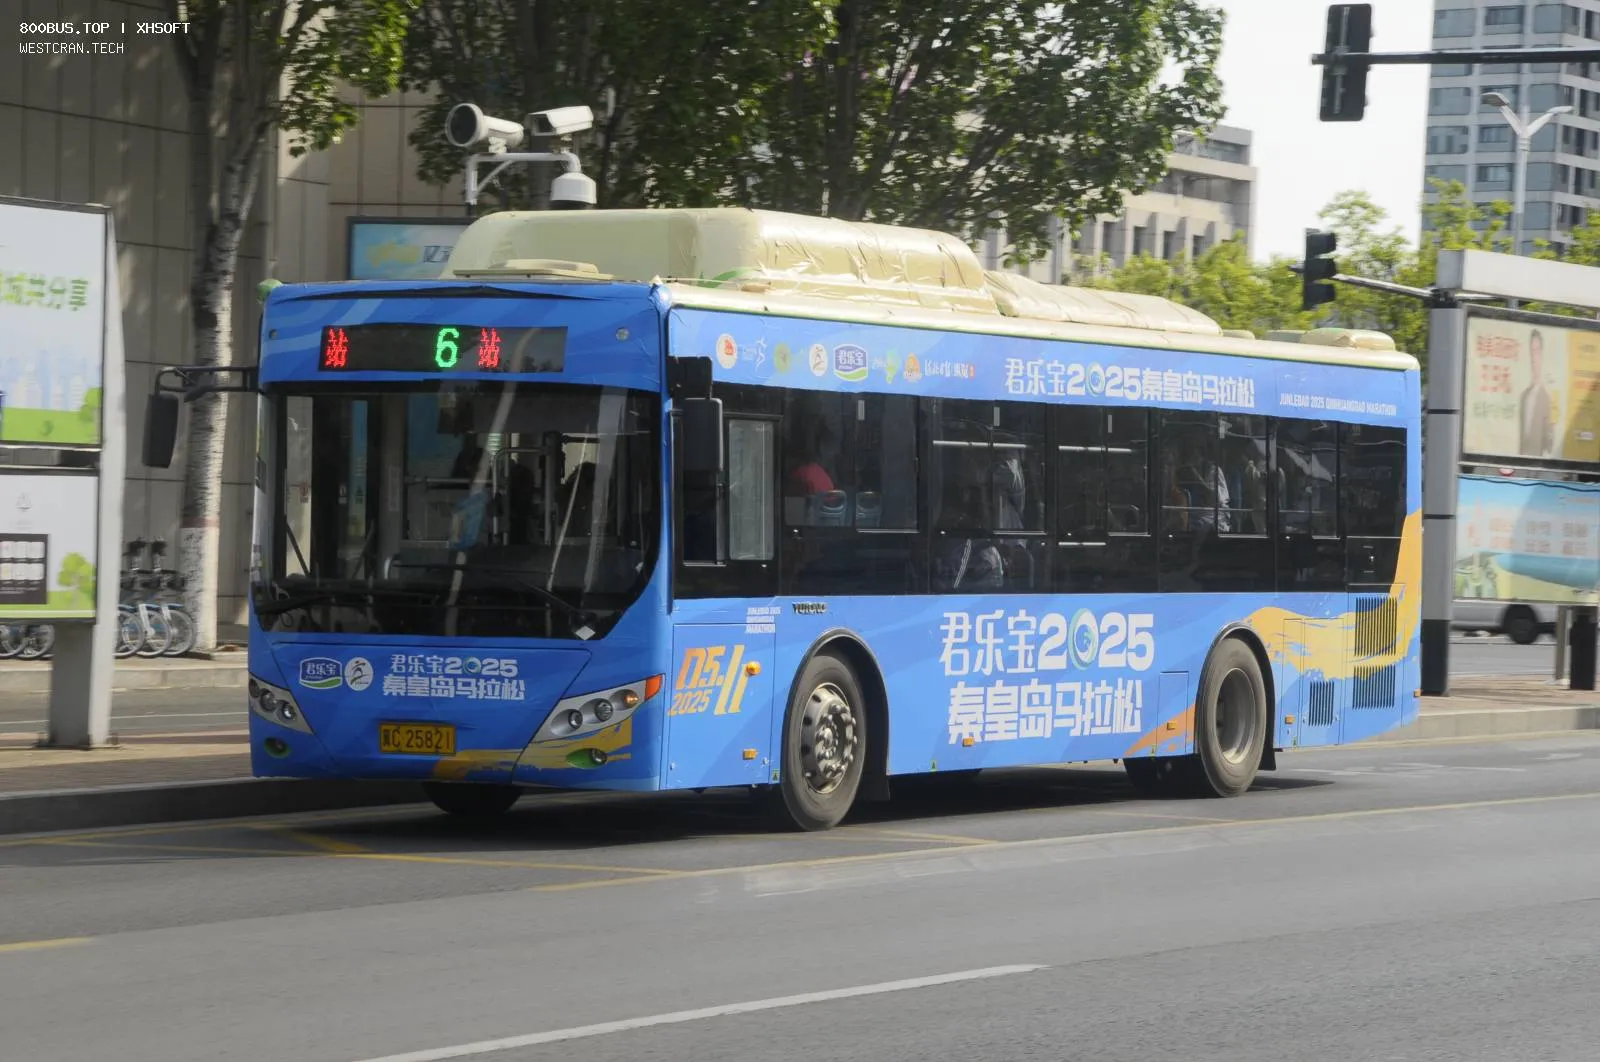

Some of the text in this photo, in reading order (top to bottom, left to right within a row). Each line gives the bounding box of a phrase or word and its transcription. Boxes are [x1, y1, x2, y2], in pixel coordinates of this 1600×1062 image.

[434, 327, 460, 368] 6
[1004, 357, 1256, 408] 君乐宝2025秦皇岛马拉松
[938, 607, 1155, 677] 君乐宝2025
[306, 662, 337, 676] 君乐宝
[390, 654, 519, 678] 君乐宝2025
[382, 674, 526, 701] 秦皇岛马拉松
[667, 689, 713, 717] 2025
[947, 677, 1143, 745] 秦皇岛马拉松
